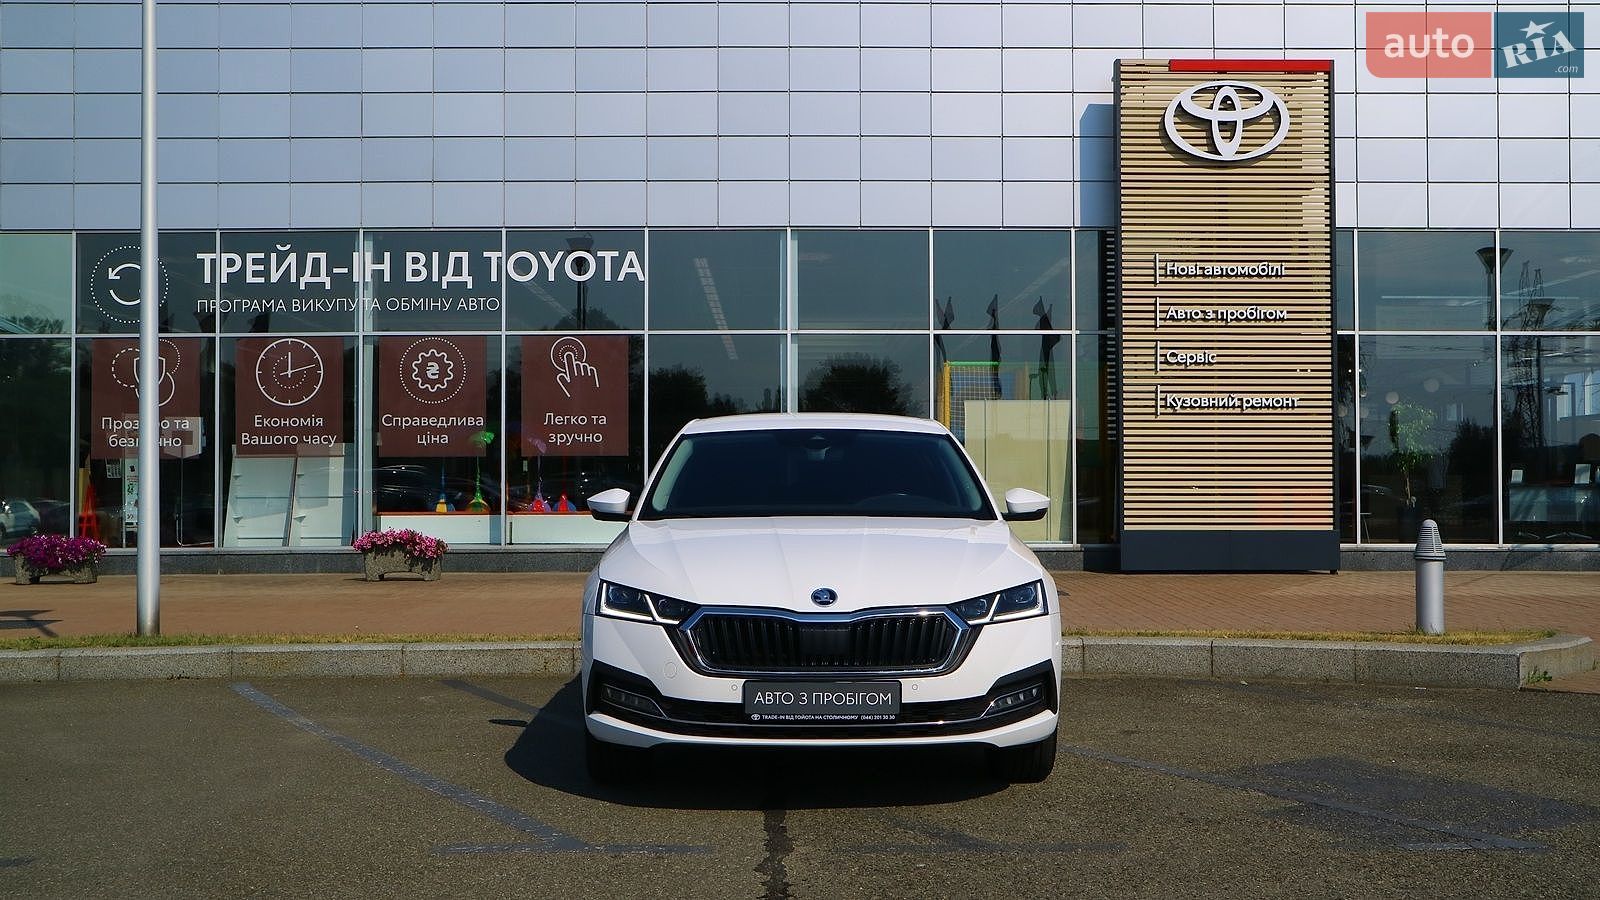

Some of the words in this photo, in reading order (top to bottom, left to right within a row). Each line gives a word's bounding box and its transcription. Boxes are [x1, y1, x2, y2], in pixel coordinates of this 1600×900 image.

[196, 243, 391, 290] ТРЕЙД-ІН
[405, 251, 473, 290] ВІД
[483, 250, 646, 282] TOYOTA
[1166, 262, 1201, 276] Нові
[1204, 261, 1286, 276] автомобілі
[197, 298, 287, 313] ПРОГРАМА
[292, 298, 358, 313] ВИКУПУ
[361, 298, 382, 312] ТА
[386, 297, 453, 312] ОБМІНУ
[456, 297, 500, 311] АВТО
[1166, 306, 1202, 320] Авто
[1205, 310, 1213, 319] з
[1218, 306, 1288, 322] пробігом
[1166, 350, 1217, 366] Сервіс
[1166, 393, 1239, 410] Кузовний
[1243, 396, 1300, 410] ремонт
[101, 417, 170, 432] Прозо
[174, 420, 190, 429] та
[254, 414, 324, 427] Економія
[381, 414, 484, 430] Справедлива
[543, 412, 588, 426] Легко
[592, 416, 607, 426] та
[241, 433, 299, 446] Вашого
[303, 434, 337, 447] часу
[417, 432, 449, 445] ціна
[548, 432, 603, 444] зручно
[754, 691, 794, 705] АВТО
[812, 691, 892, 706] ПРОБІГОМ
